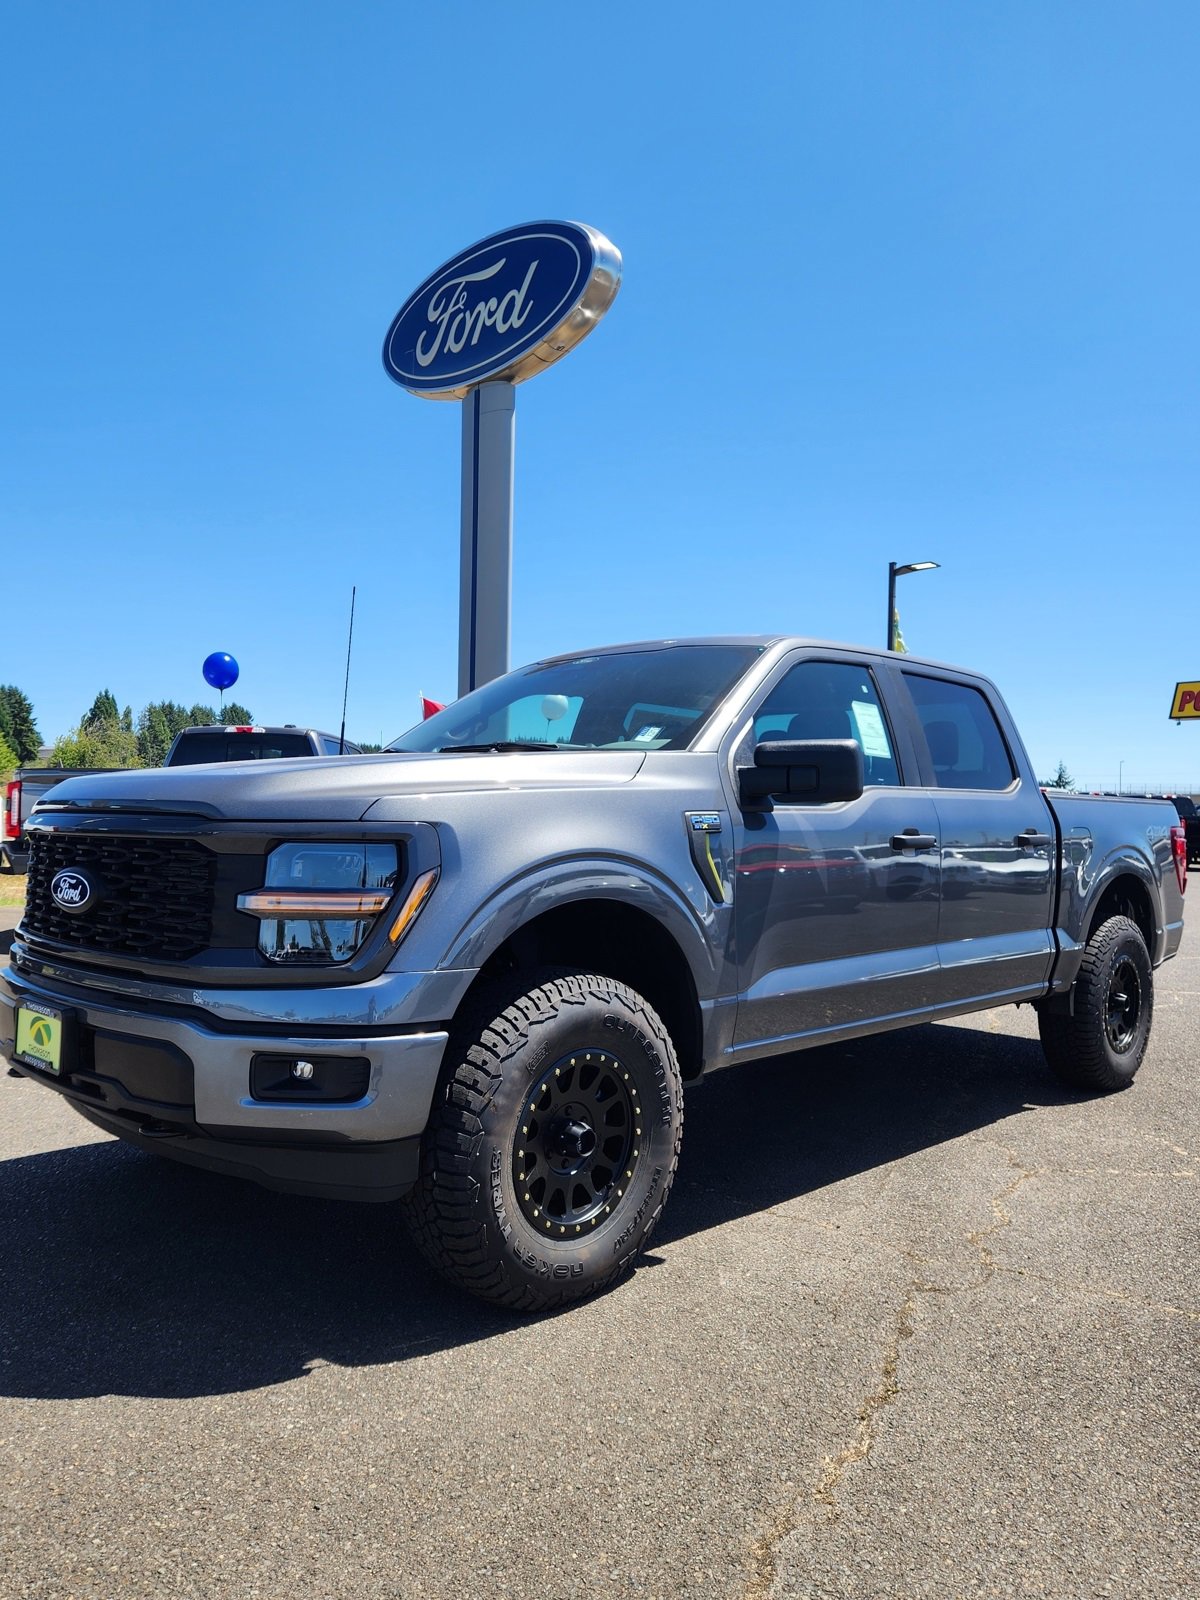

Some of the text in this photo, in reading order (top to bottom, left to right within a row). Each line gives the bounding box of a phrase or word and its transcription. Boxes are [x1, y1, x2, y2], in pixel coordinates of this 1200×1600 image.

[415, 257, 540, 367] Ford
[57, 876, 82, 902] Ford
[490, 1148, 513, 1242] TYRES
